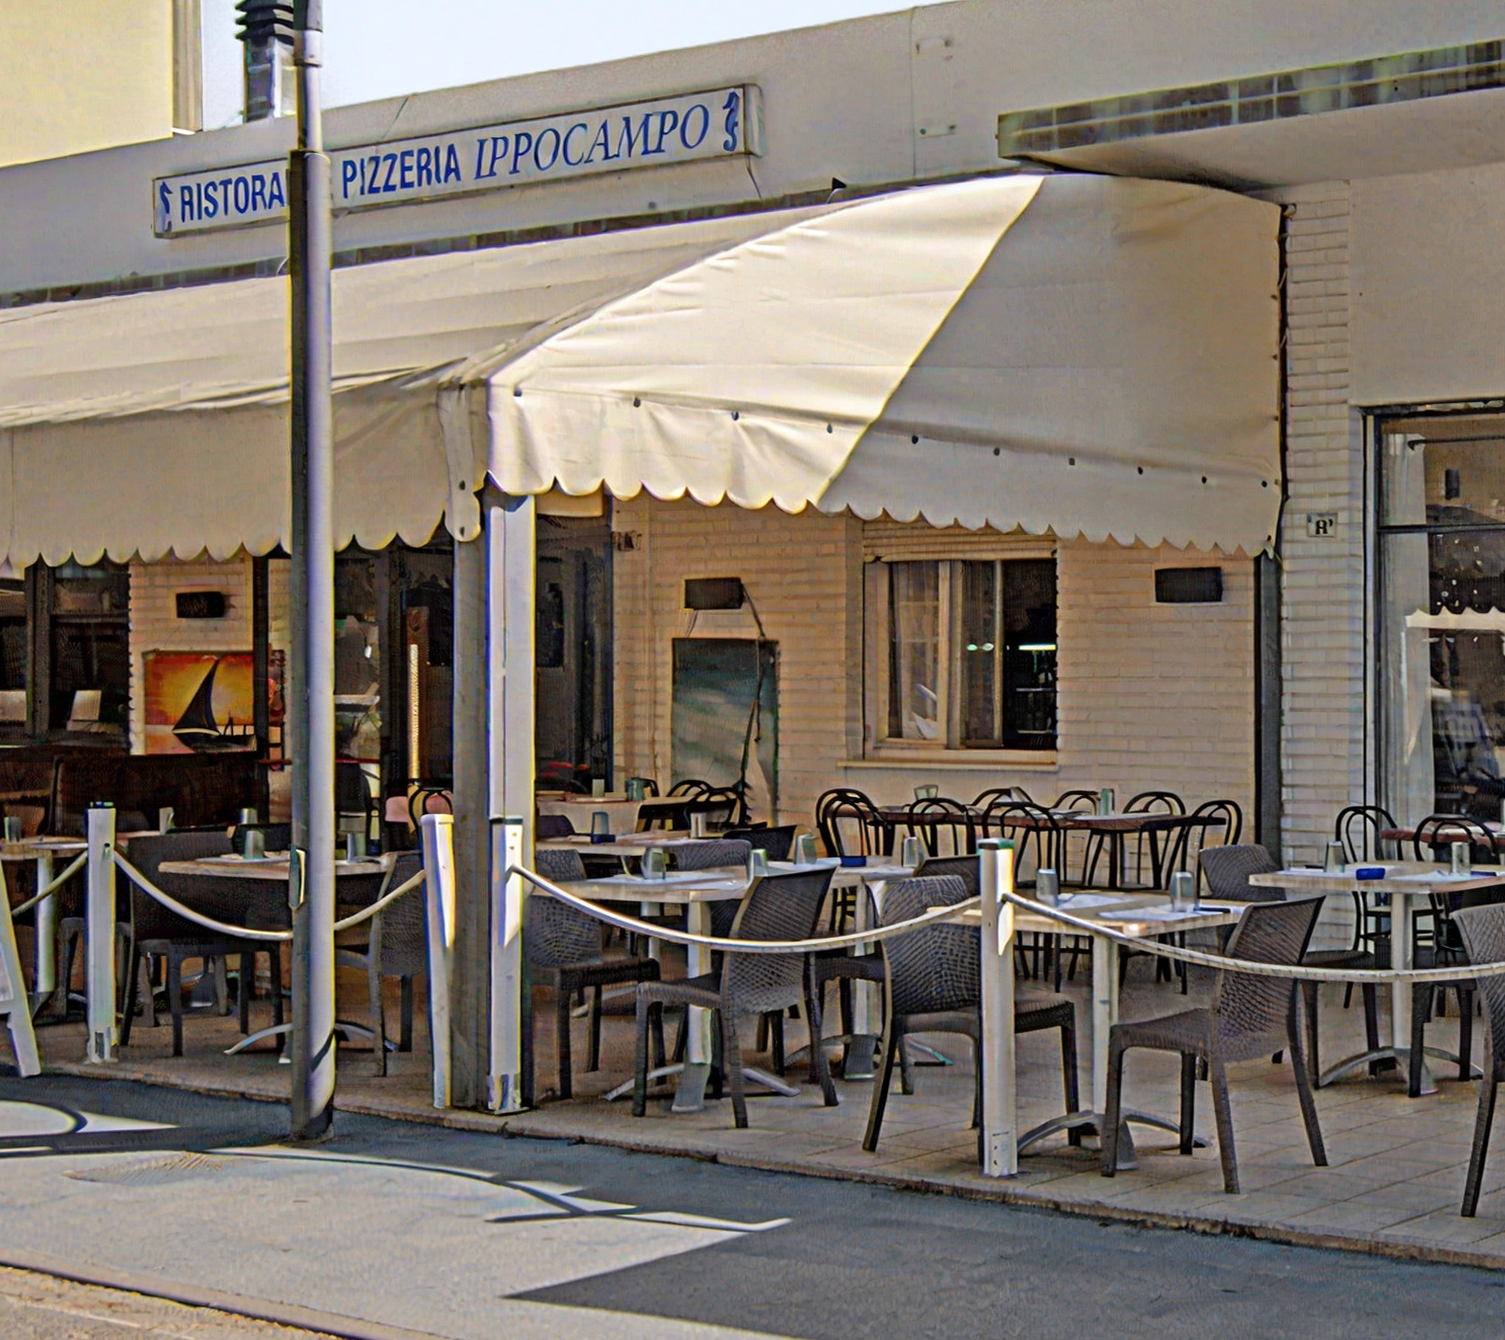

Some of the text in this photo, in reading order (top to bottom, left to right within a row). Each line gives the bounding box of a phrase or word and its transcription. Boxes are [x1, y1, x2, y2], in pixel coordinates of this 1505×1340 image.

[180, 103, 711, 223] RISTORA PIZZERIA IPPOCAMPO
